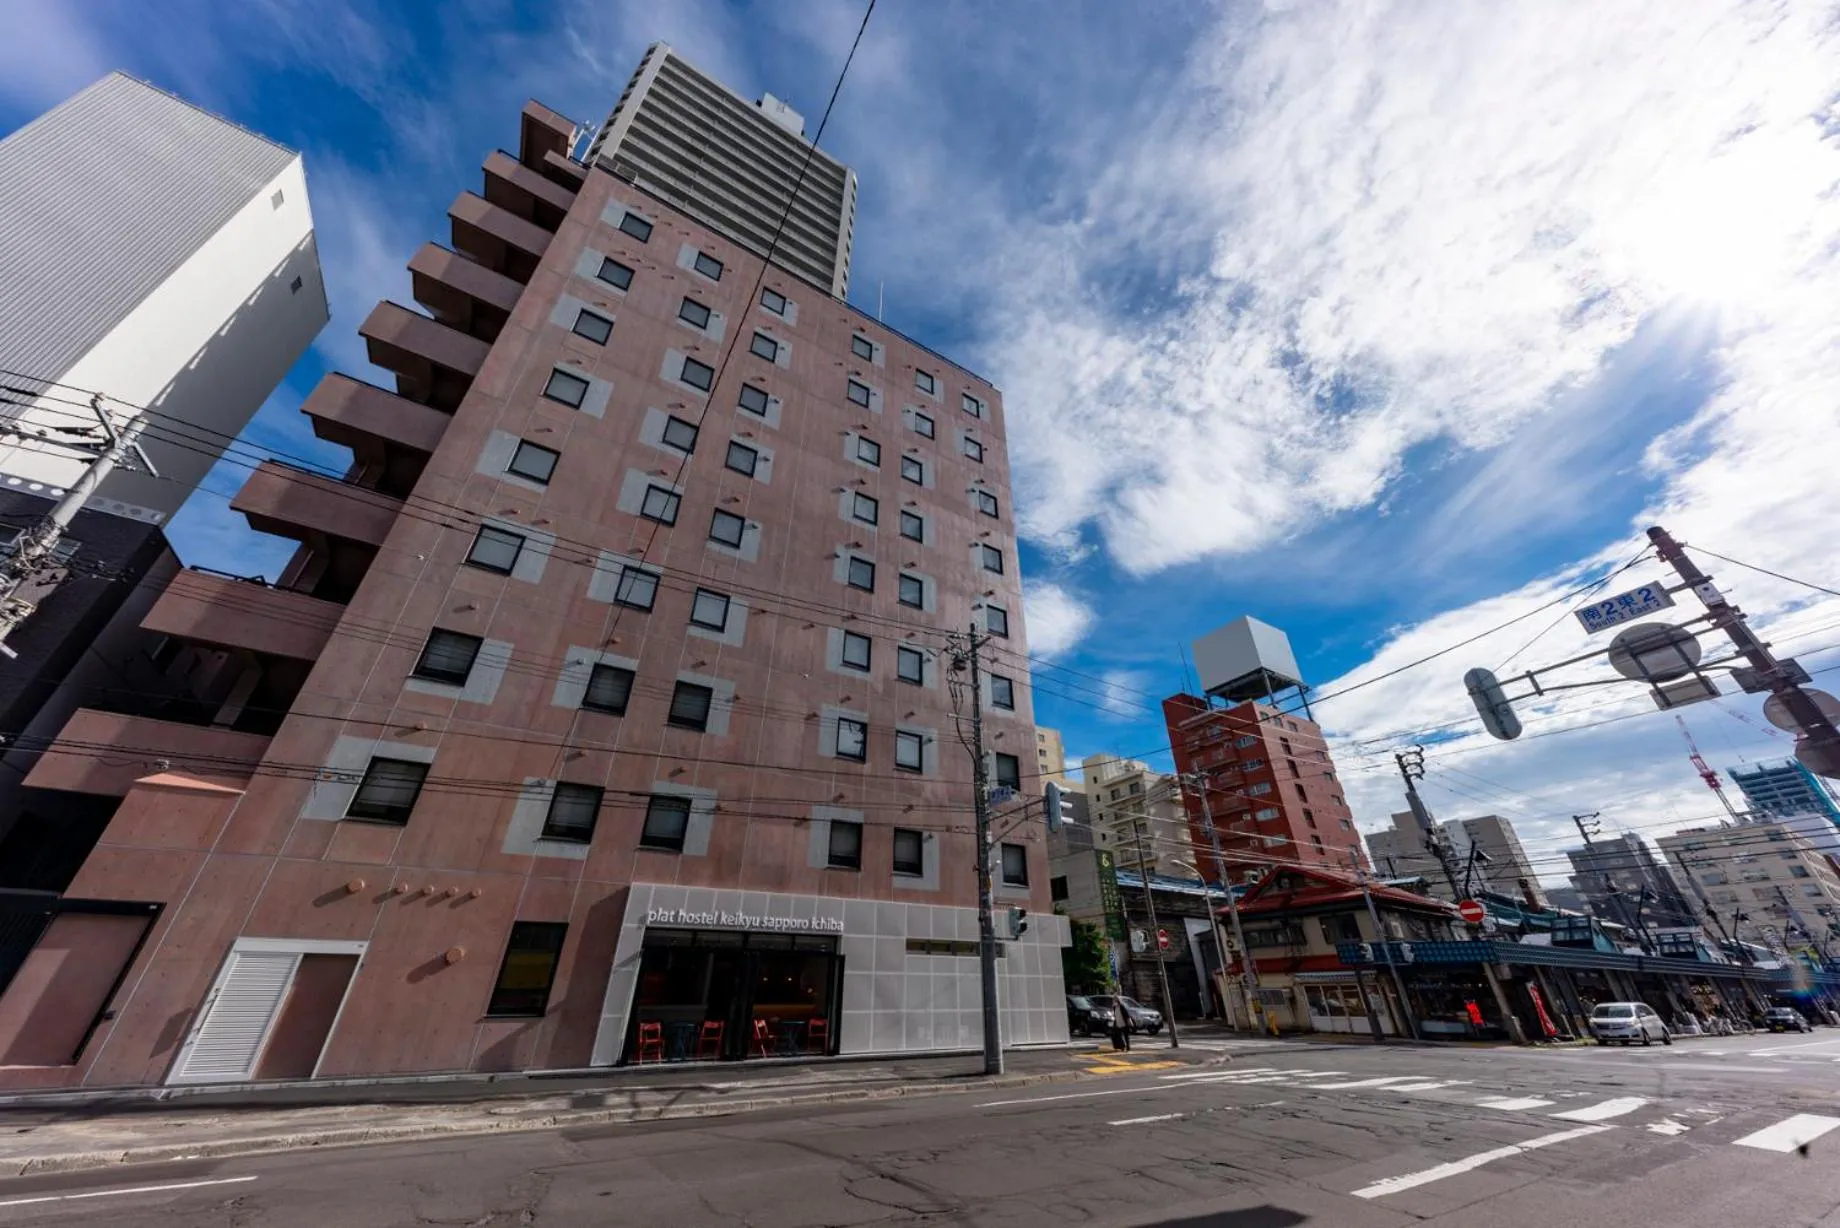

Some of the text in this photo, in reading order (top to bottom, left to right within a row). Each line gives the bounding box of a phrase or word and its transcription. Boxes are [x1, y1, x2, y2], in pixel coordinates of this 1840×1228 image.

[1589, 615, 1616, 630] South
[1629, 603, 1652, 615] East
[648, 907, 844, 932] plat hostel keikyu sapporo ichiba
